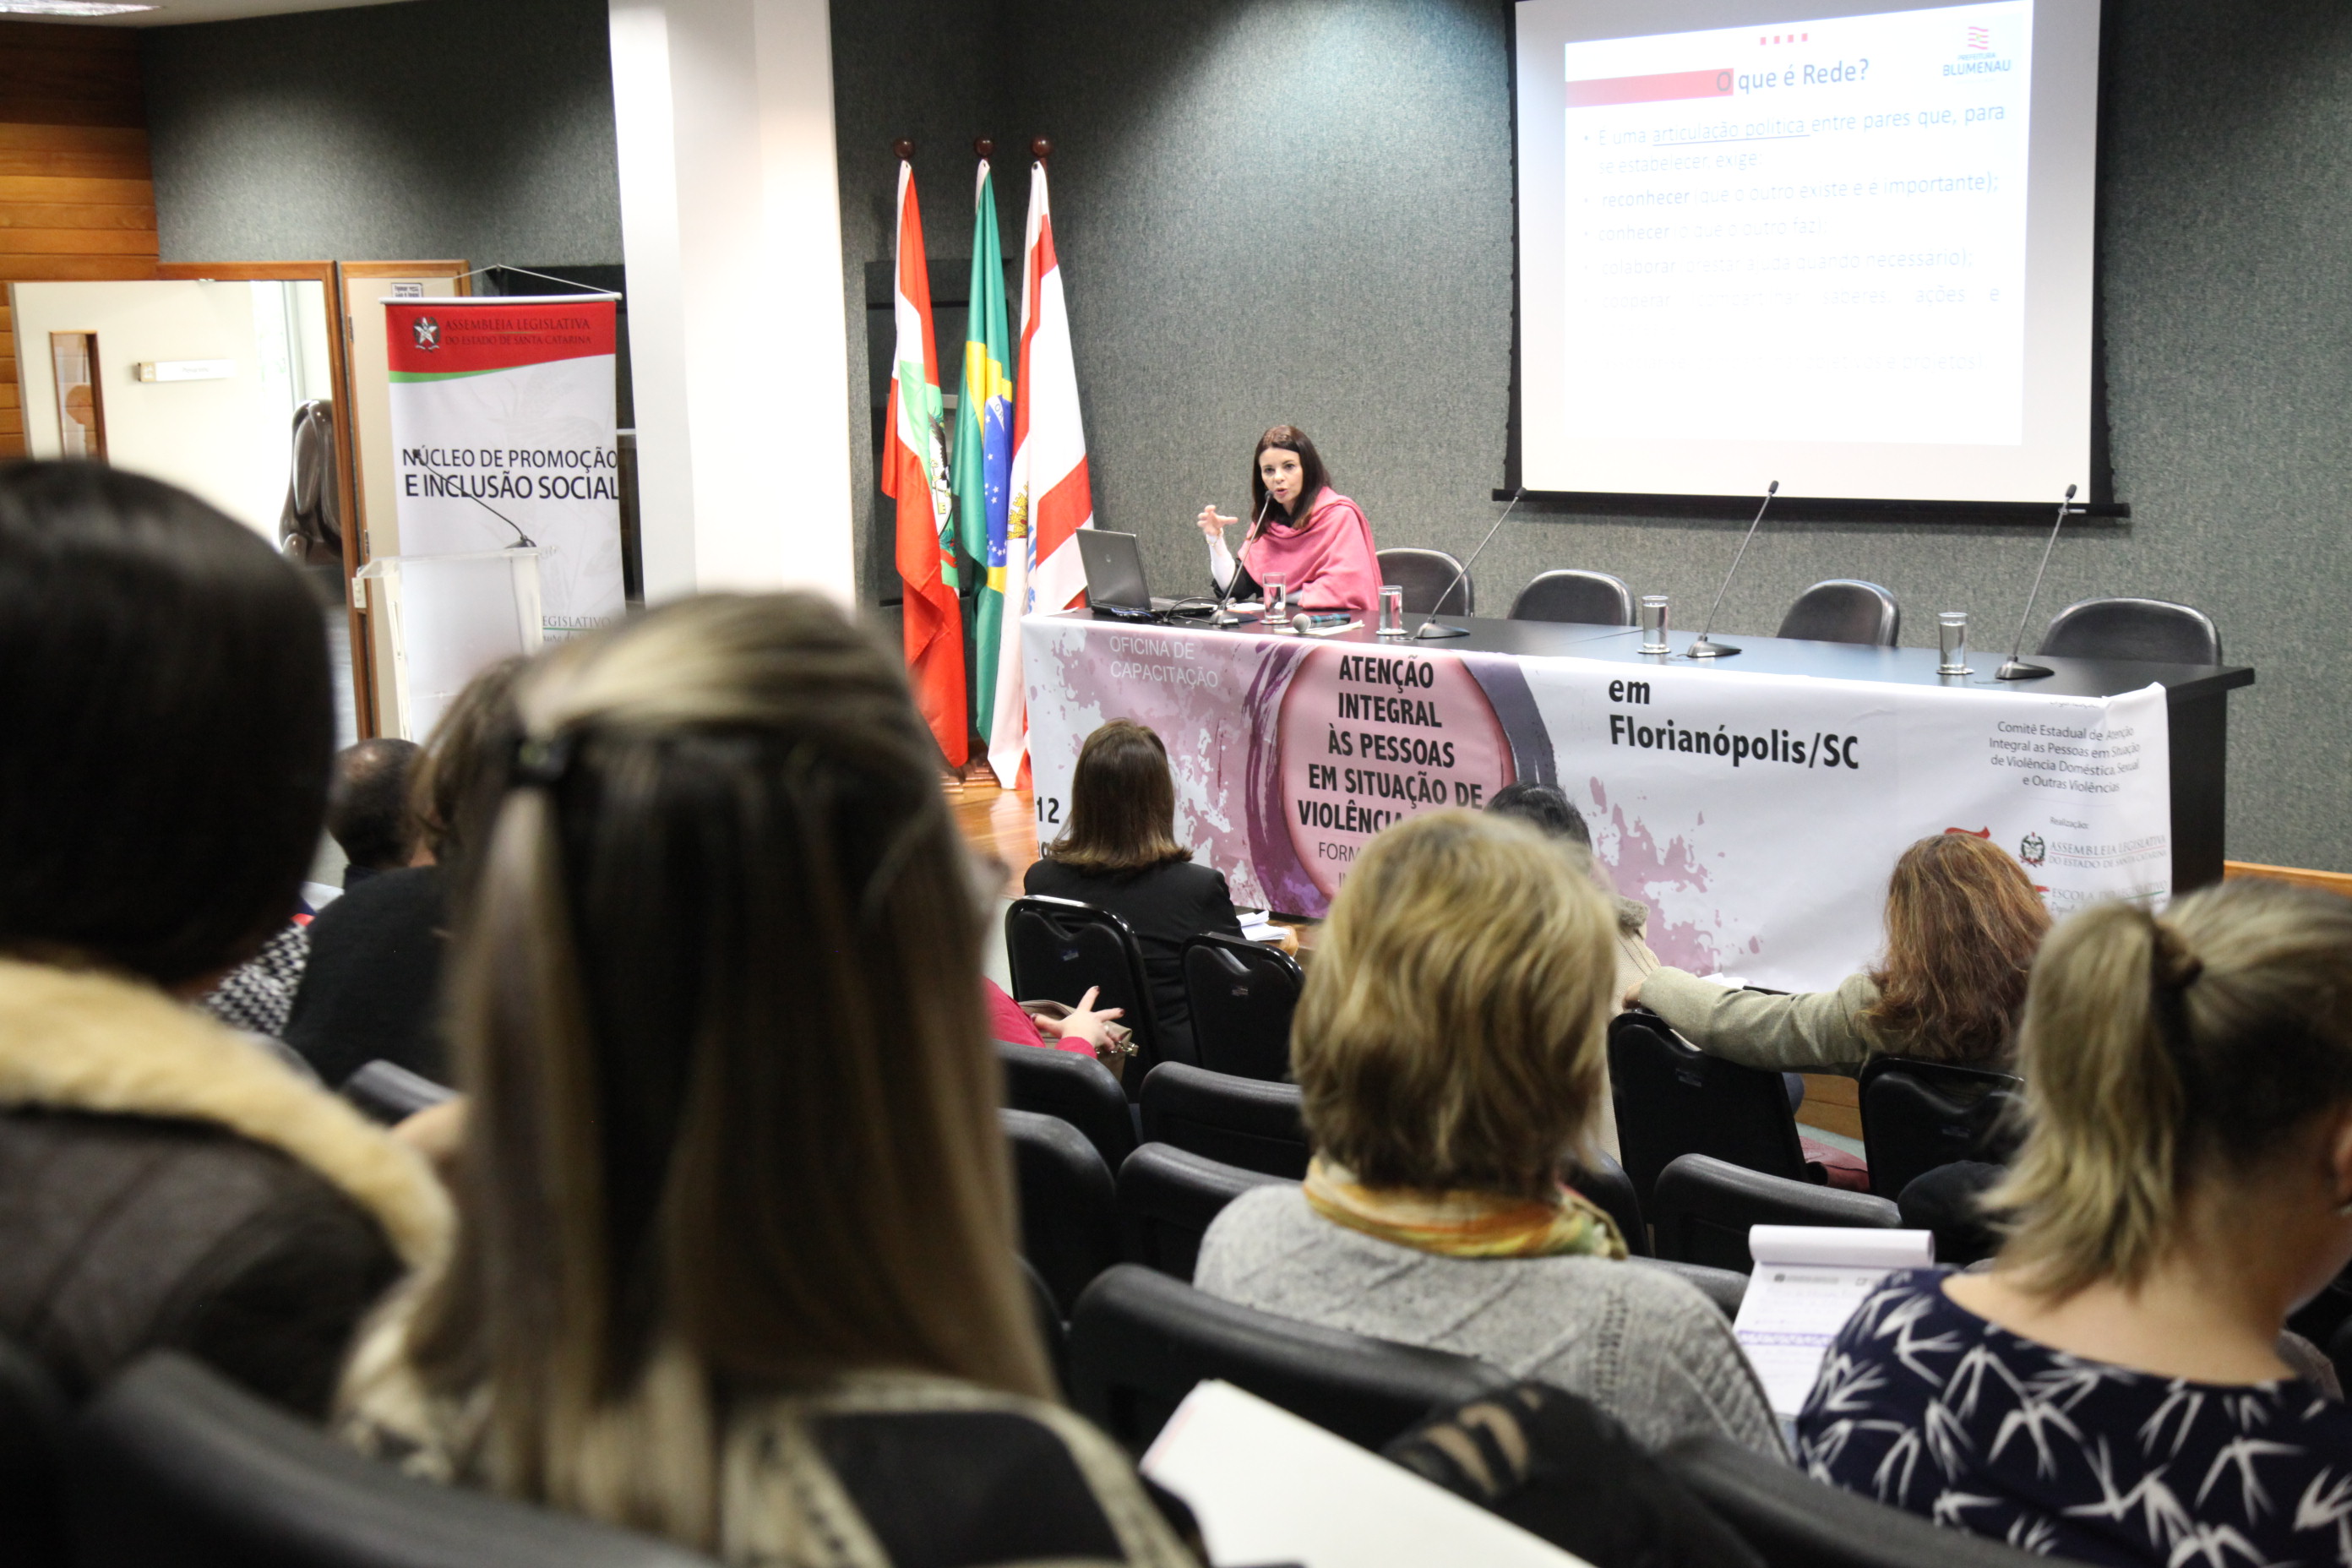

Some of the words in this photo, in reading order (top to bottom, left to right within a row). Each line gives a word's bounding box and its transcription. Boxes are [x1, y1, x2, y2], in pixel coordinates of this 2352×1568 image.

[1717, 71, 1732, 92] O
[1739, 70, 1777, 95] que
[1783, 63, 1795, 86] é
[1804, 58, 1870, 85] Rede?
[1942, 59, 2012, 76] BLUMENAU
[1613, 128, 1647, 144] uma
[1652, 121, 1739, 143] articulação
[1811, 115, 1855, 133] entre
[1864, 112, 1910, 133] pares
[1964, 106, 2005, 128] para
[1602, 188, 1690, 208] reconhecer
[1750, 184, 1794, 201] outro
[1883, 172, 1999, 194] importante);
[1598, 224, 1669, 242] conhecer
[445, 318, 514, 330] ASSEMBLEIA
[517, 318, 591, 330] LEGISLATIVA
[500, 335, 512, 346] DE
[514, 335, 542, 346] SANTA
[544, 335, 591, 345] CATARINA
[402, 445, 475, 467] NÚCLEO
[480, 449, 504, 467] DE
[509, 446, 618, 473] PROMOÇÃO
[406, 474, 419, 497] E
[424, 471, 533, 499] INCLUSÃO
[538, 476, 619, 500] SOCIAL
[542, 615, 610, 627] EGISLATIVO
[1109, 635, 1170, 657] OFICINA
[1173, 642, 1195, 660] DE
[1110, 661, 1217, 689] CAPACITAÇÃO
[1339, 655, 1435, 694] ATENÇÃO
[1609, 679, 1650, 705] em
[1338, 692, 1443, 728] INTEGRAL
[1609, 714, 1859, 770] Florianópolis/SC
[1997, 721, 2038, 737] Comitê
[2039, 724, 2087, 740] Estadual
[2089, 729, 2103, 741] de
[1328, 723, 1353, 756] ÀS
[1359, 732, 1456, 769] PESSOAS
[1989, 738, 2030, 753] Integral
[2033, 742, 2044, 753] as
[2048, 743, 2089, 757] Pessoas
[2091, 749, 2110, 759] em
[1990, 755, 2004, 765] de
[2006, 755, 2056, 771] Violência
[1309, 763, 1337, 792] EM
[1344, 768, 1447, 809] SITUAÇÃO
[1454, 781, 1483, 810] DE
[2023, 776, 2029, 786] e
[2032, 775, 2067, 790] Outras
[2069, 779, 2121, 794] Violências
[1037, 797, 1059, 824] 12
[2050, 841, 2116, 857] ASSEMBLEIA
[2064, 858, 2100, 868] ESTADO
[2051, 888, 2095, 901] ESCOLA
